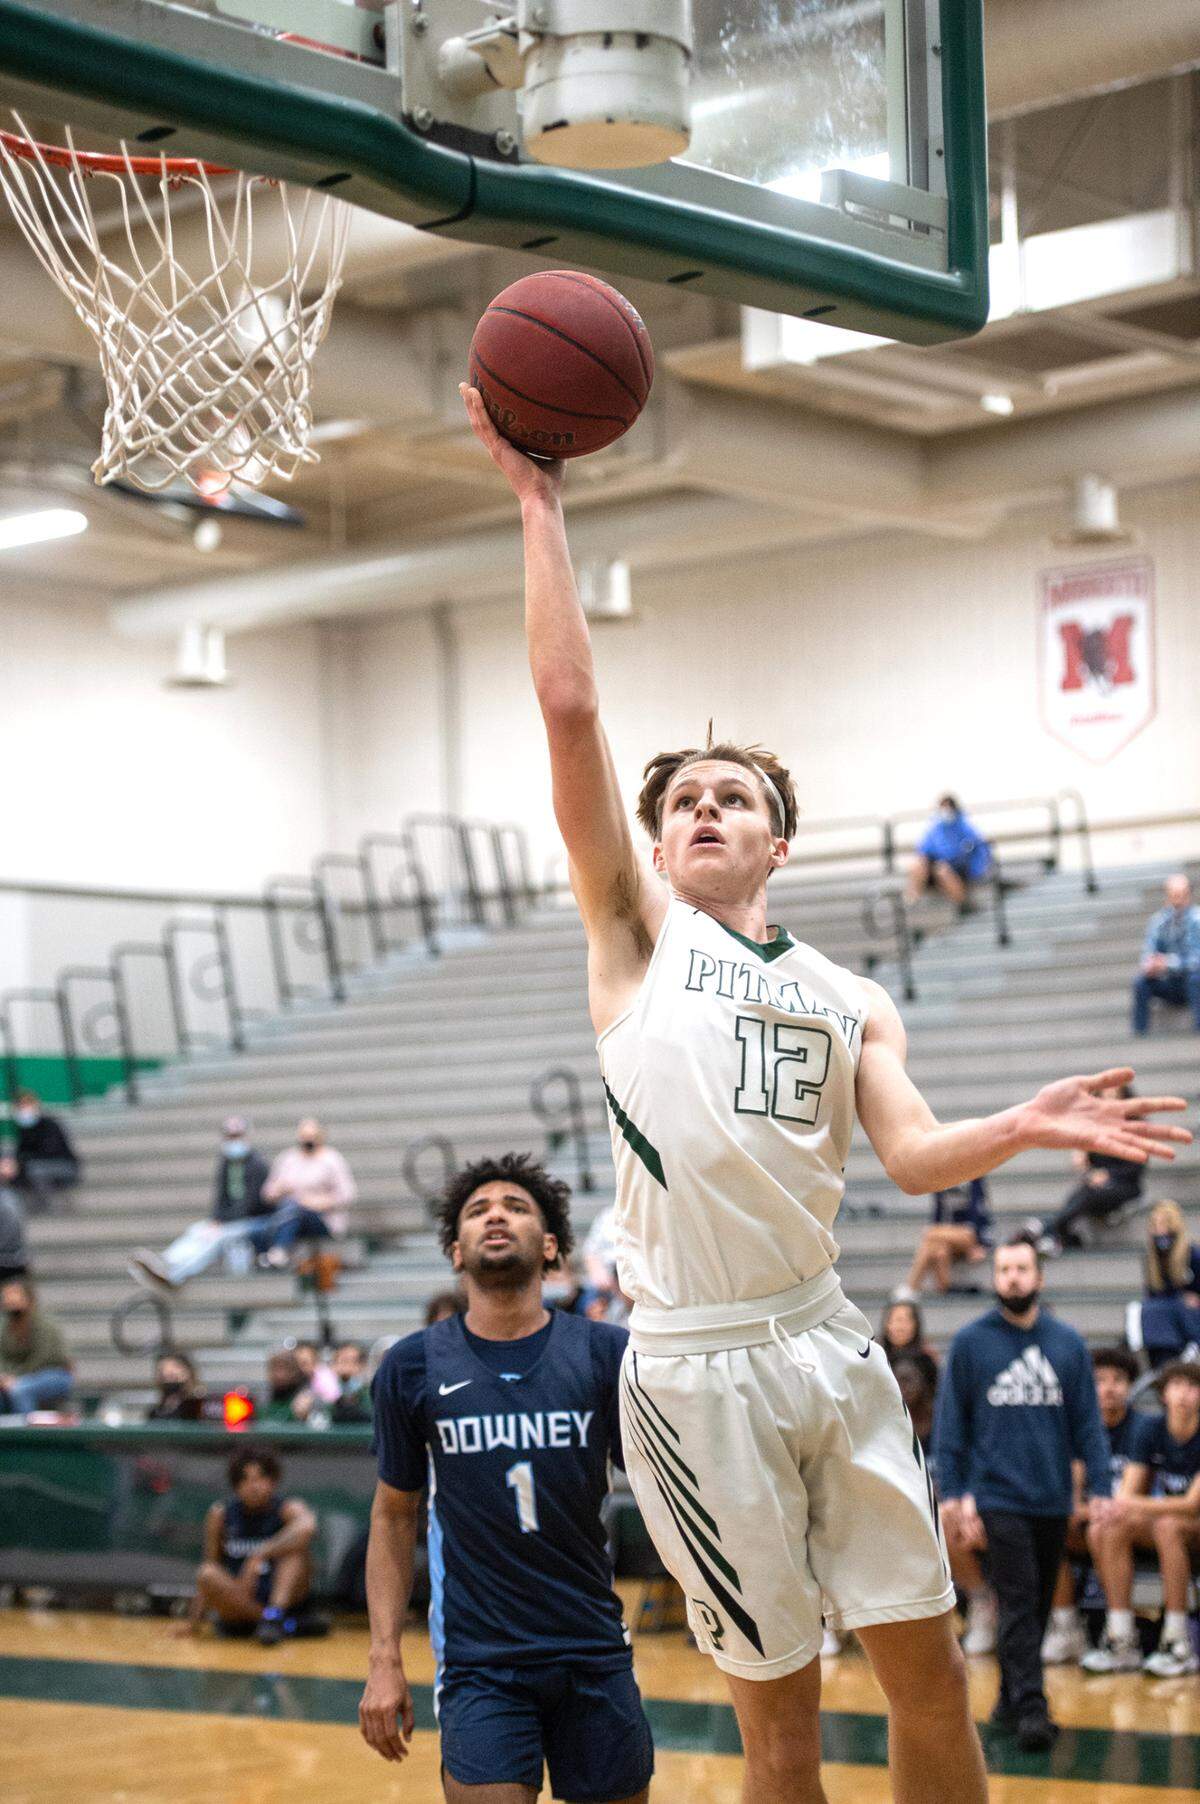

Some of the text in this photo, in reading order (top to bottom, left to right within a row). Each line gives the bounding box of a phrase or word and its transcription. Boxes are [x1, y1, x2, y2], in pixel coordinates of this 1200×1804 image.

[685, 949, 858, 1049] PITMN
[734, 1015, 832, 1126] 12
[435, 1411, 595, 1455] DOWNEY
[506, 1460, 541, 1534] 1
